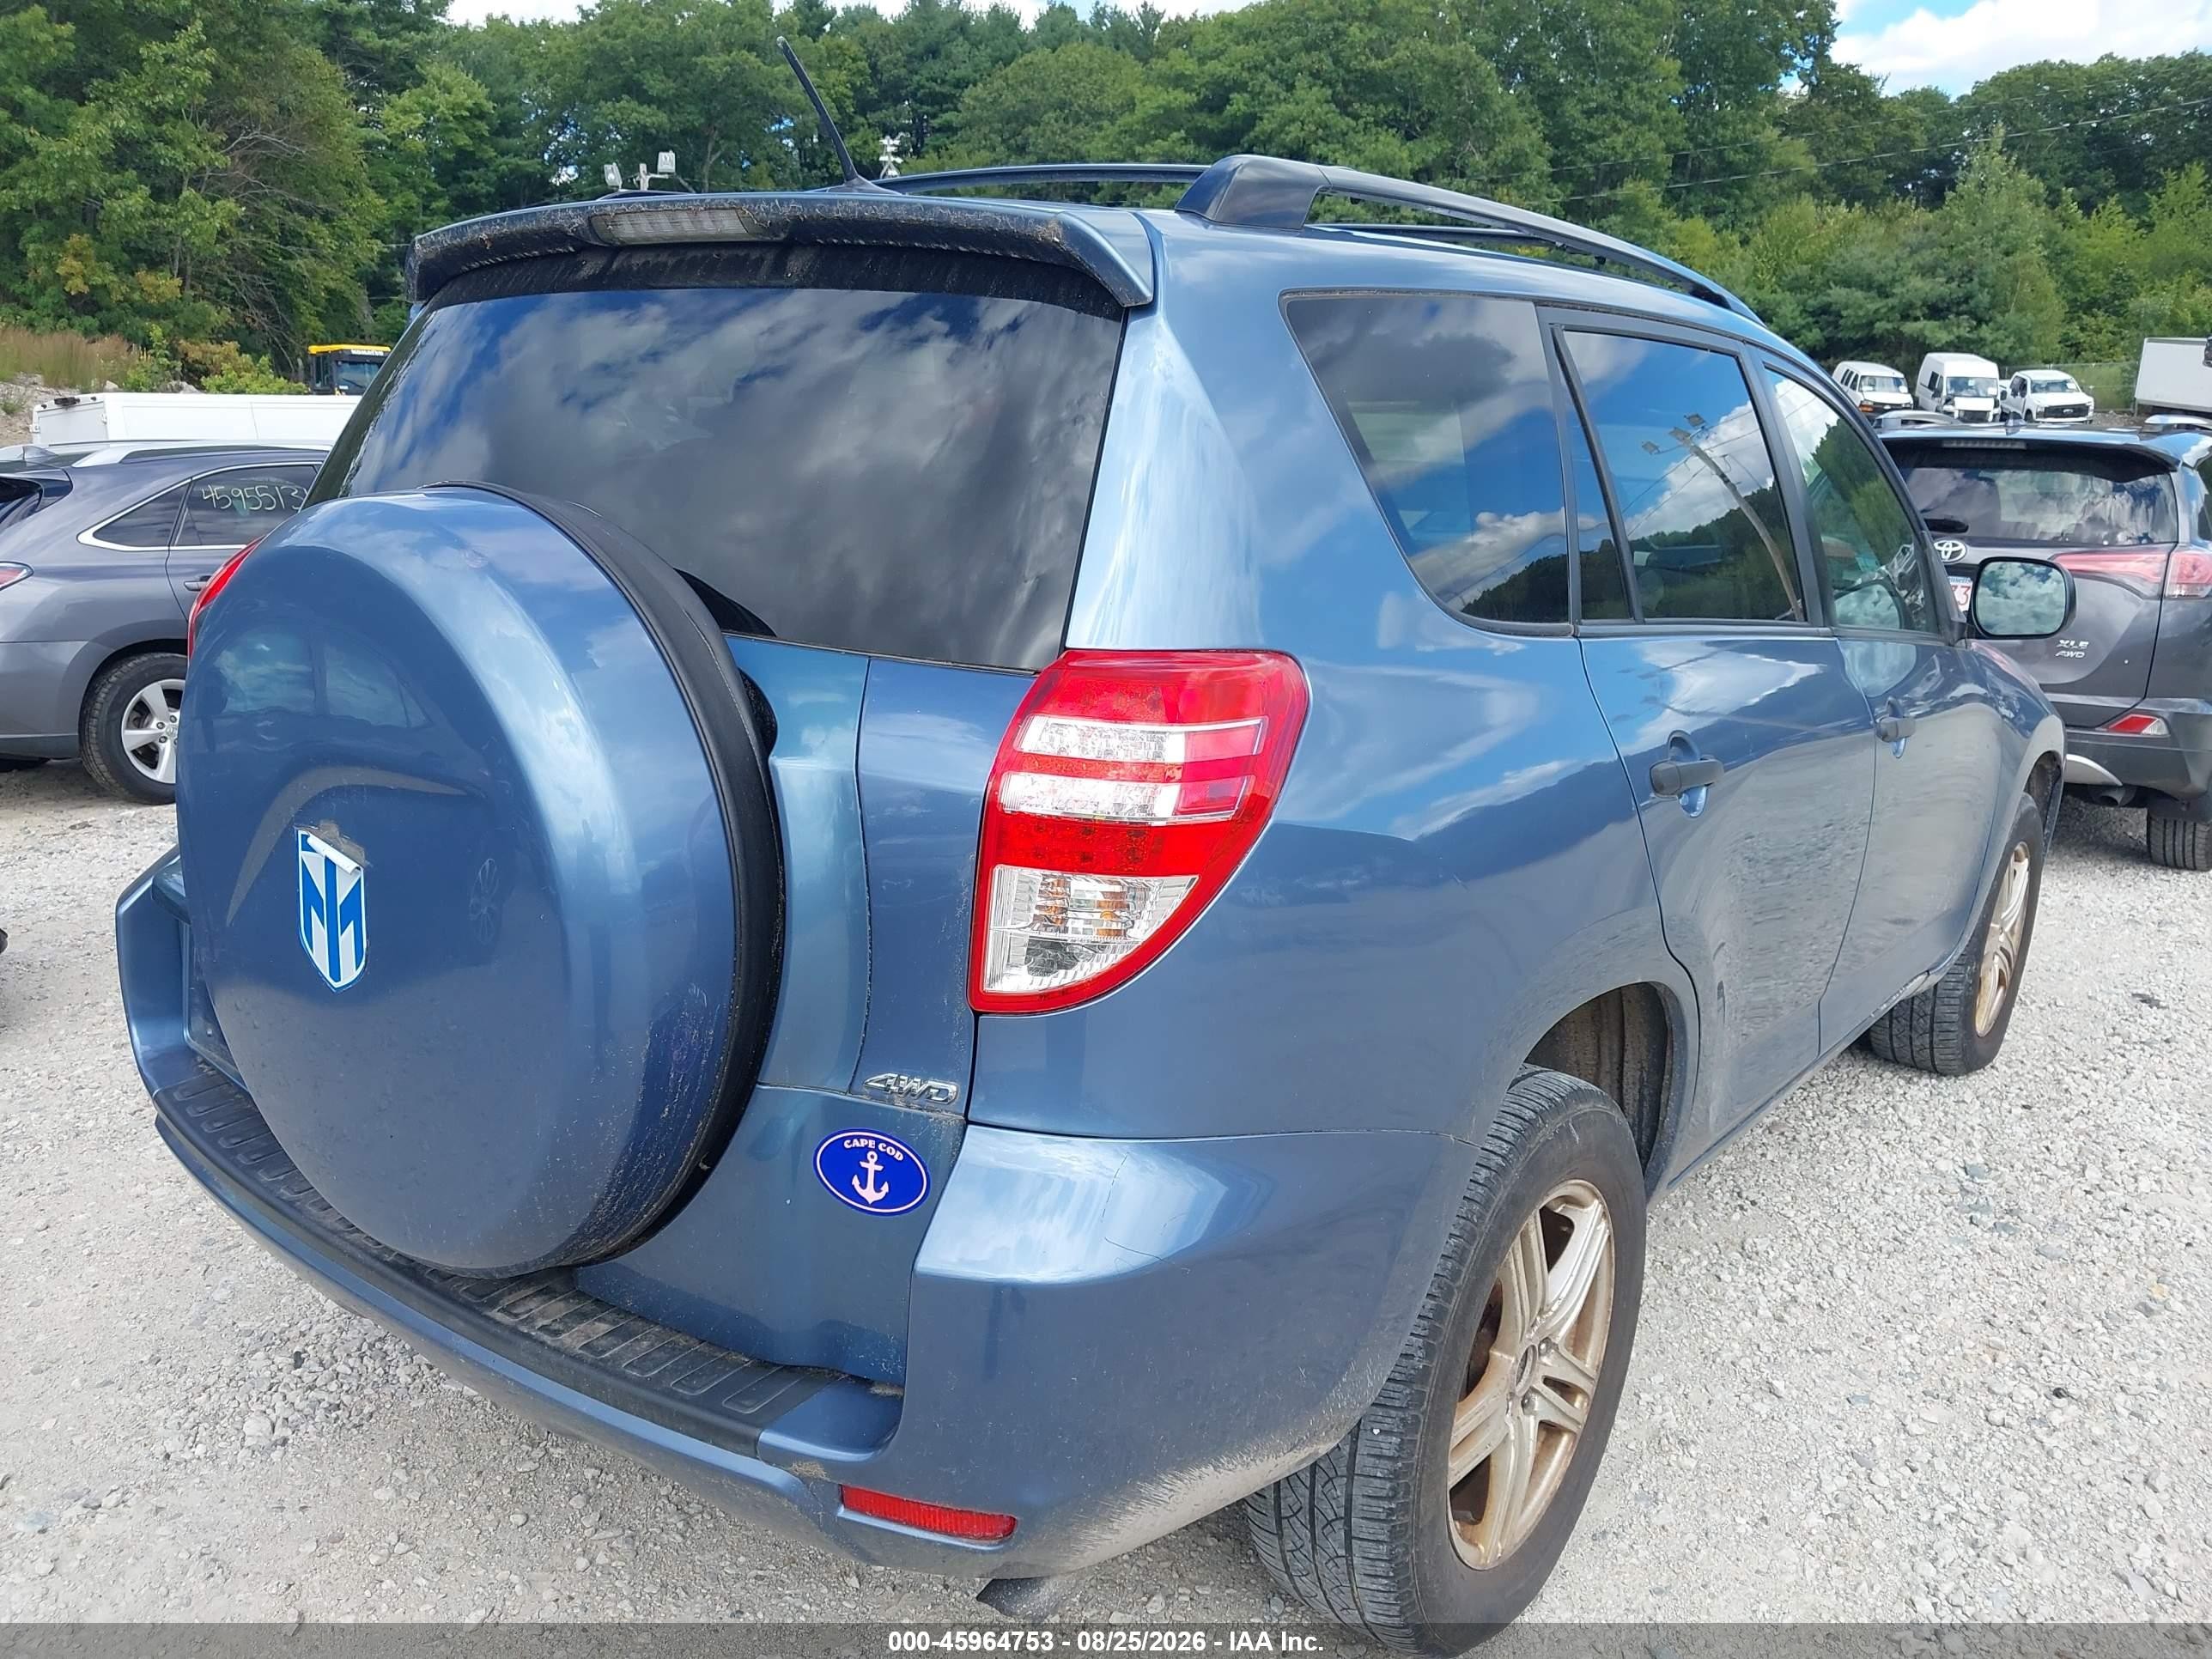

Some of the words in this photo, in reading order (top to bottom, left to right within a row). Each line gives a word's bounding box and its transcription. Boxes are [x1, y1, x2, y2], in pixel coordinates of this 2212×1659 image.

[2057, 639, 2089, 649] XLE
[2055, 650, 2086, 659] AWD
[863, 1073, 958, 1104] 4WD
[843, 1138, 876, 1149] CAPE
[878, 1142, 904, 1161] COD
